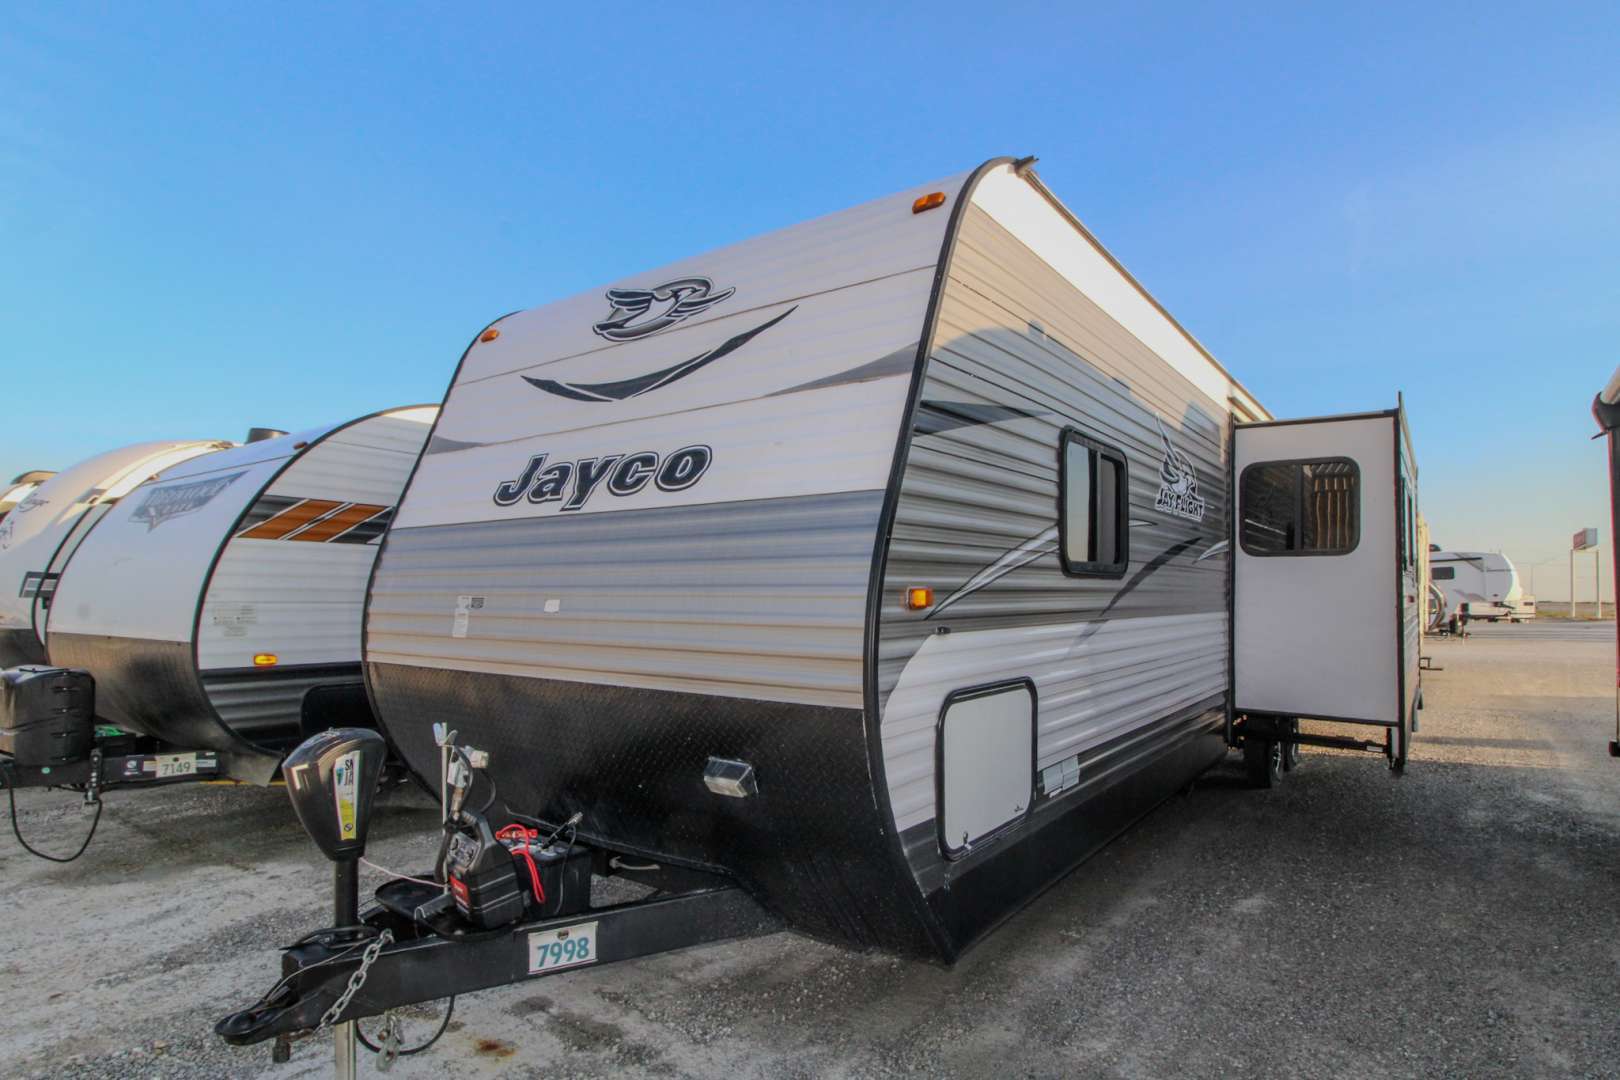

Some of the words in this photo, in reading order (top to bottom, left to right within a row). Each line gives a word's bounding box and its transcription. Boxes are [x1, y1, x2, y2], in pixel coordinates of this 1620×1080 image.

[493, 444, 713, 512] Jayco
[1156, 487, 1175, 508] JAY
[1175, 494, 1204, 517] FLIGHT
[161, 761, 192, 776] 7149
[536, 936, 590, 968] 7998
